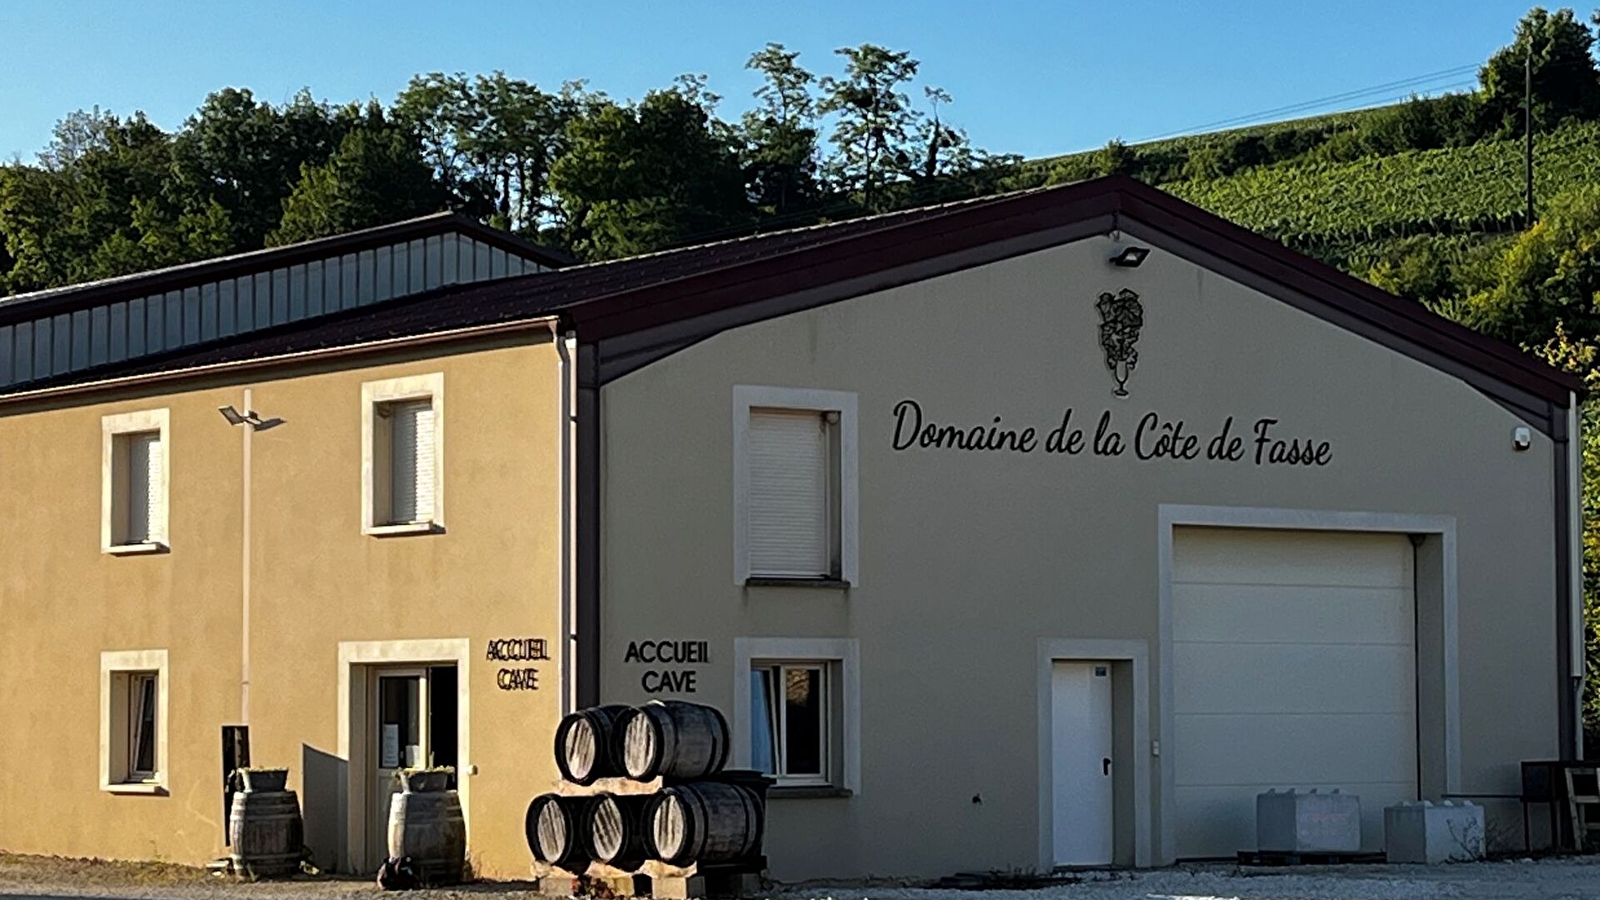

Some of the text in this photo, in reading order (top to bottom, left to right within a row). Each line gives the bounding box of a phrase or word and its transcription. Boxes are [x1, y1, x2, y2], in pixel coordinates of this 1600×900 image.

[892, 399, 1333, 466] Domaine de la Côte de Fasse
[486, 638, 551, 662] ACCUEIL
[497, 667, 540, 691] CAVE
[641, 670, 697, 694] CAVE
